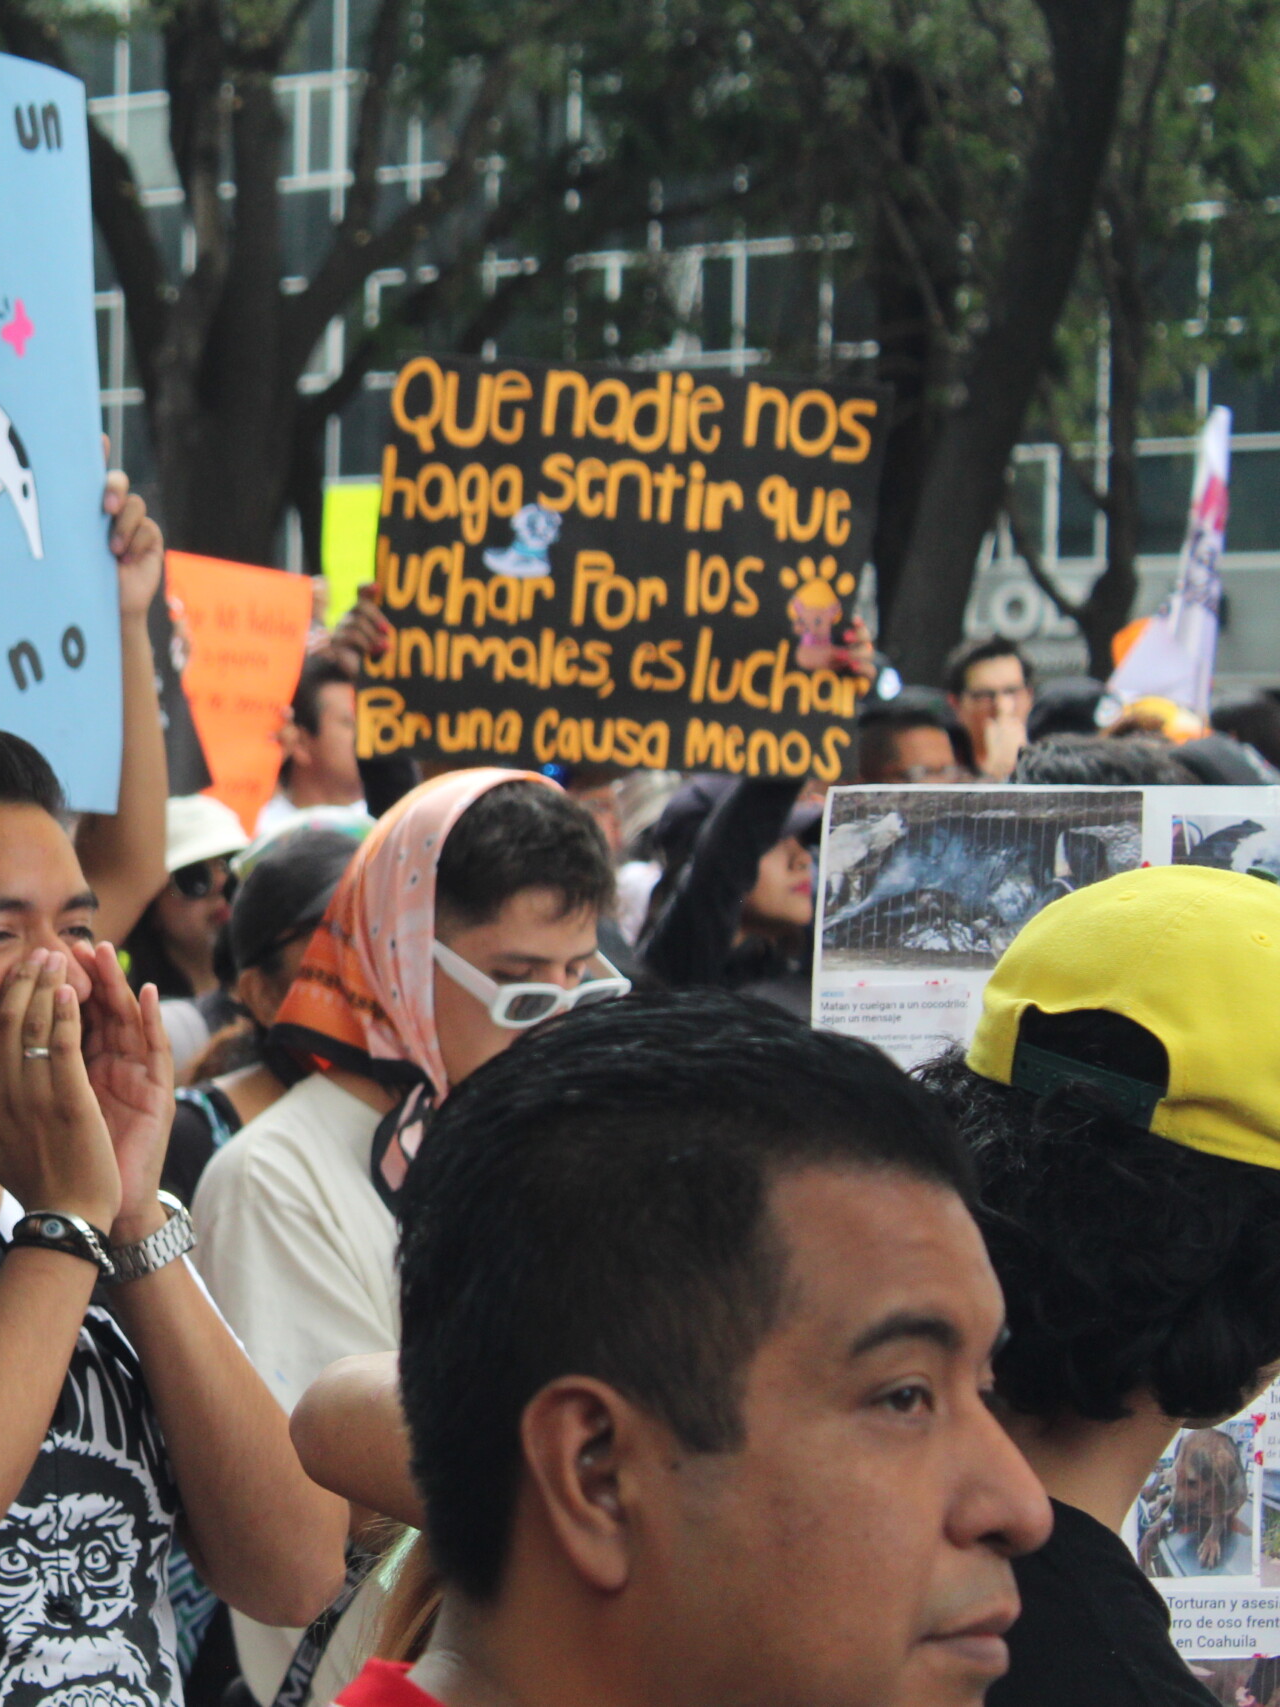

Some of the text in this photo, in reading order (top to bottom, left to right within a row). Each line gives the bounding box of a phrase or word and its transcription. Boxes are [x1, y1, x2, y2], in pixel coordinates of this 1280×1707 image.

[14, 103, 62, 151] un
[391, 357, 878, 464] Que nadie nos
[381, 444, 852, 546] haga sentir que
[376, 535, 556, 627] luchar
[684, 550, 765, 617] los
[630, 640, 686, 691] es
[689, 626, 871, 719] luchar
[437, 708, 523, 753] una
[1166, 1596, 1280, 1612] Torturan y asesi
[1172, 1619, 1192, 1629] rro
[1196, 1615, 1213, 1629] de
[1216, 1619, 1243, 1629] oso
[1176, 1634, 1257, 1648] en Coahuila
